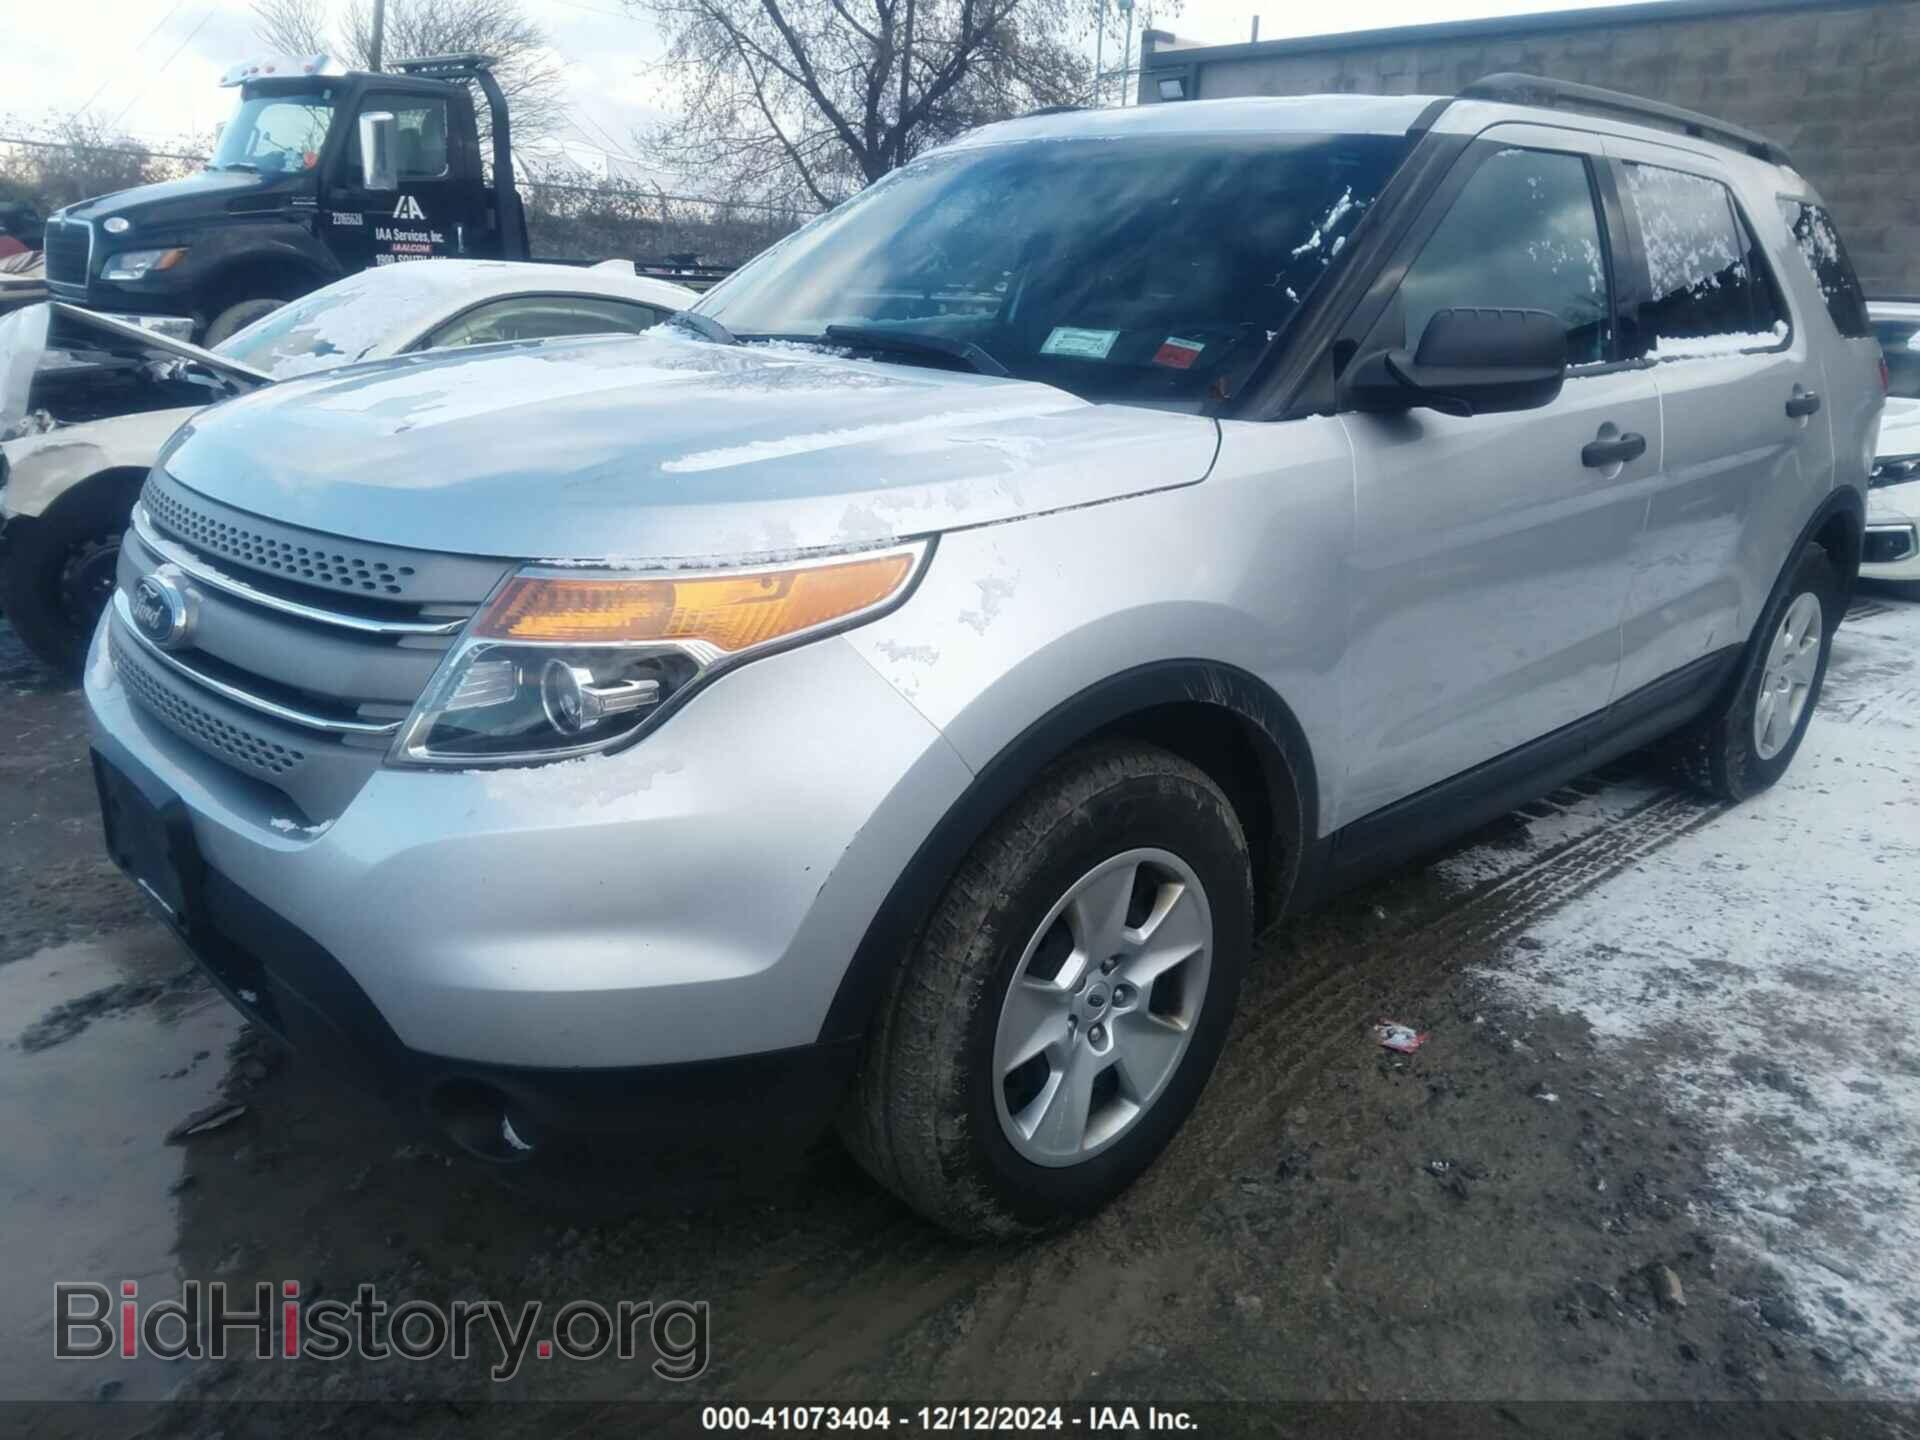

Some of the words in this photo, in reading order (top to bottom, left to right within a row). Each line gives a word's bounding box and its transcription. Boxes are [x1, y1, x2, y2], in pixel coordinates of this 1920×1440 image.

[375, 227, 393, 241] IAA
[393, 228, 431, 243] Services,
[430, 229, 445, 243] Inc.
[134, 583, 163, 630] Ford
